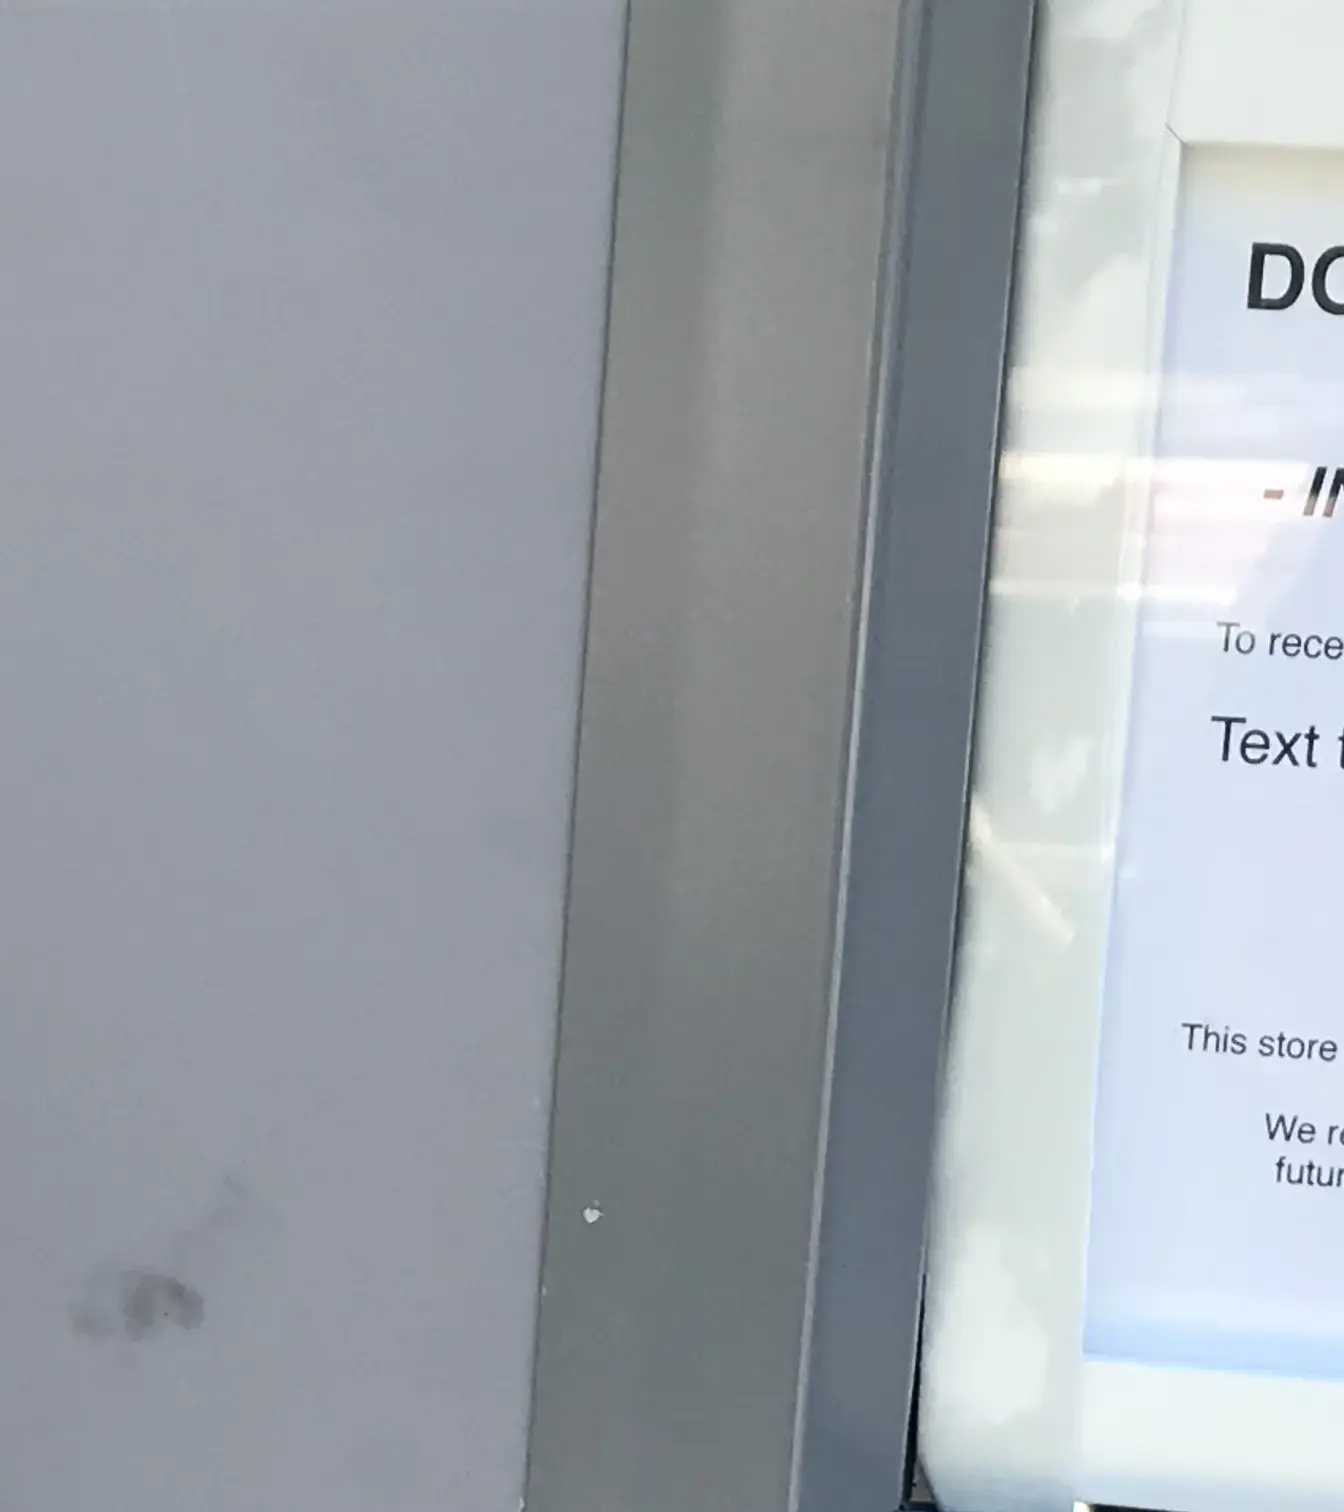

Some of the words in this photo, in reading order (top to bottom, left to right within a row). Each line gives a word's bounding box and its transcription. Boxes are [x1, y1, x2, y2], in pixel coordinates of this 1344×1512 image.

[1216, 621, 1256, 656] To
[1210, 715, 1321, 769] Text
[1181, 1022, 1248, 1056] This
[1257, 1031, 1339, 1063] store
[1265, 1112, 1317, 1145] We
